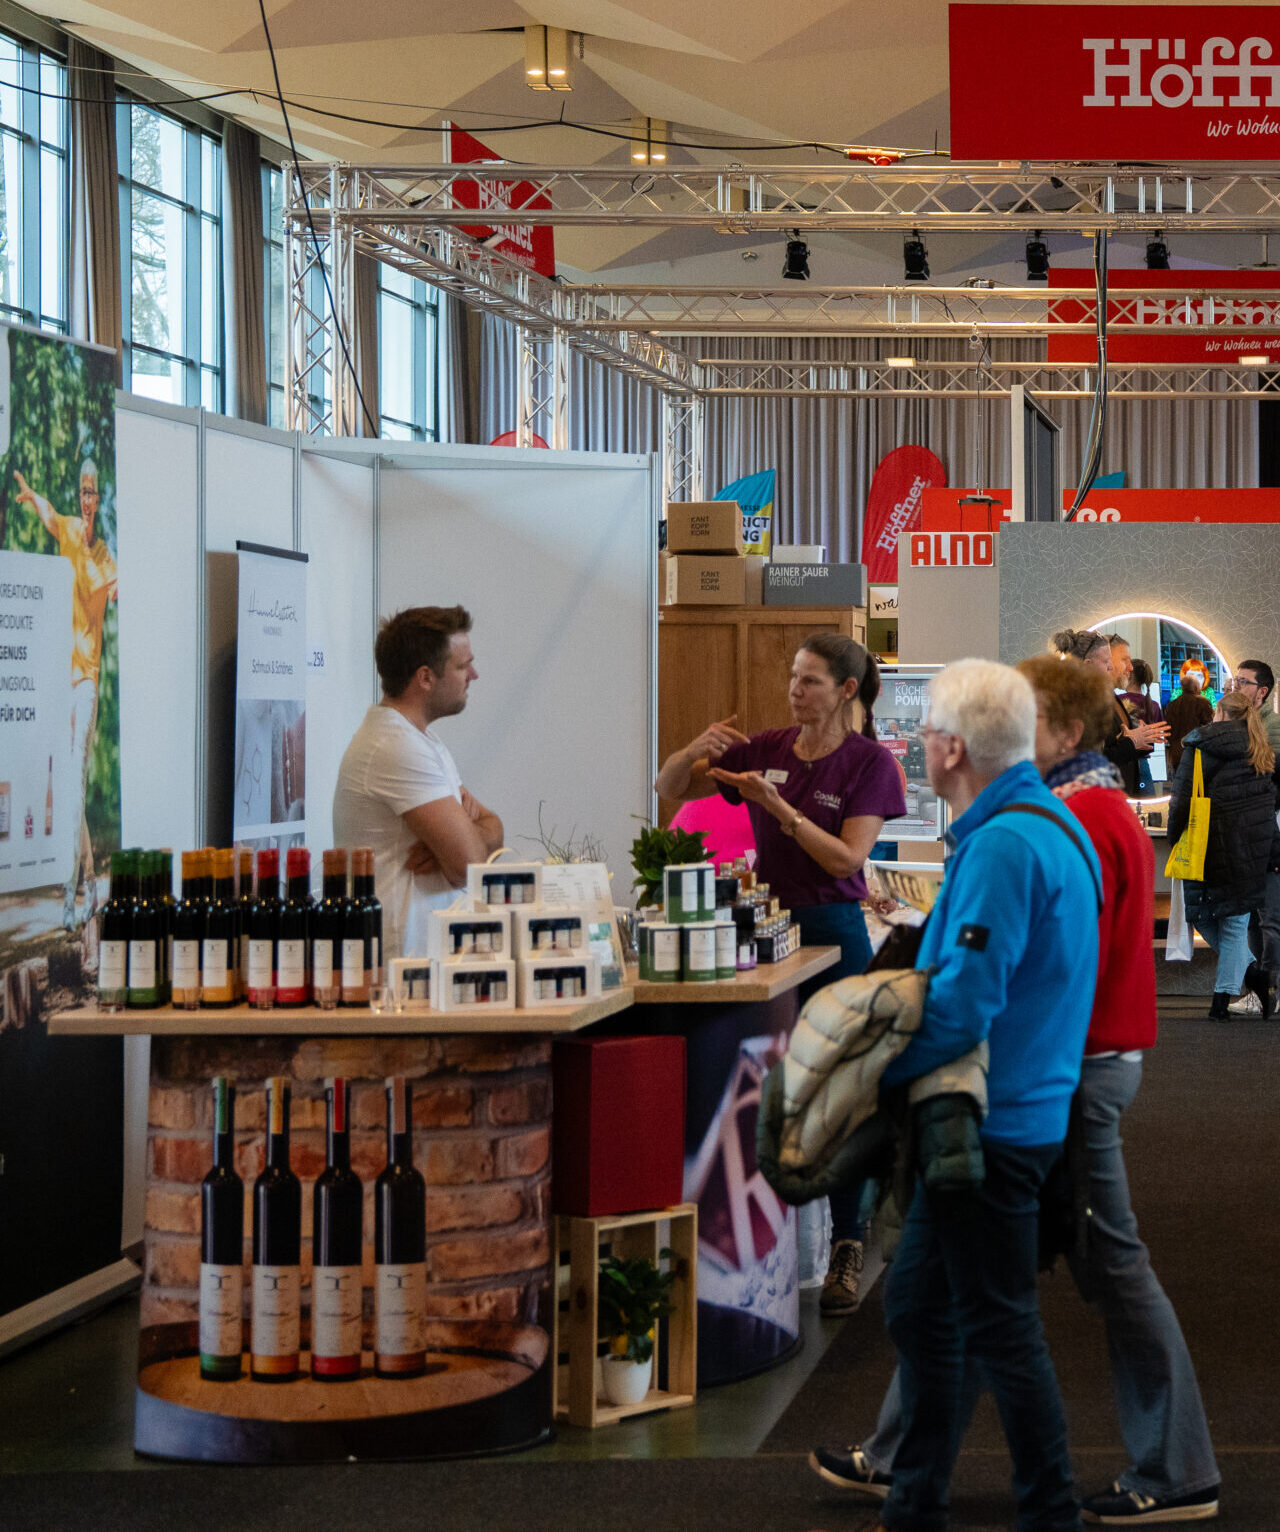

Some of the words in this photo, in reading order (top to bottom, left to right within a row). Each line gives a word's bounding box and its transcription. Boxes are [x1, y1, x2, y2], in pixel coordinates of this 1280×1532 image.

[1207, 119, 1232, 137] Wo
[1205, 340, 1220, 352] Wo
[1224, 337, 1262, 351] Wohnen
[875, 475, 926, 554] Höffner
[911, 534, 993, 566] ALNO
[769, 567, 800, 577] RAINER
[802, 567, 829, 577] SAUER
[769, 577, 805, 587] WEINGUT
[0, 703, 14, 722] FÜR
[16, 707, 36, 722] DICH
